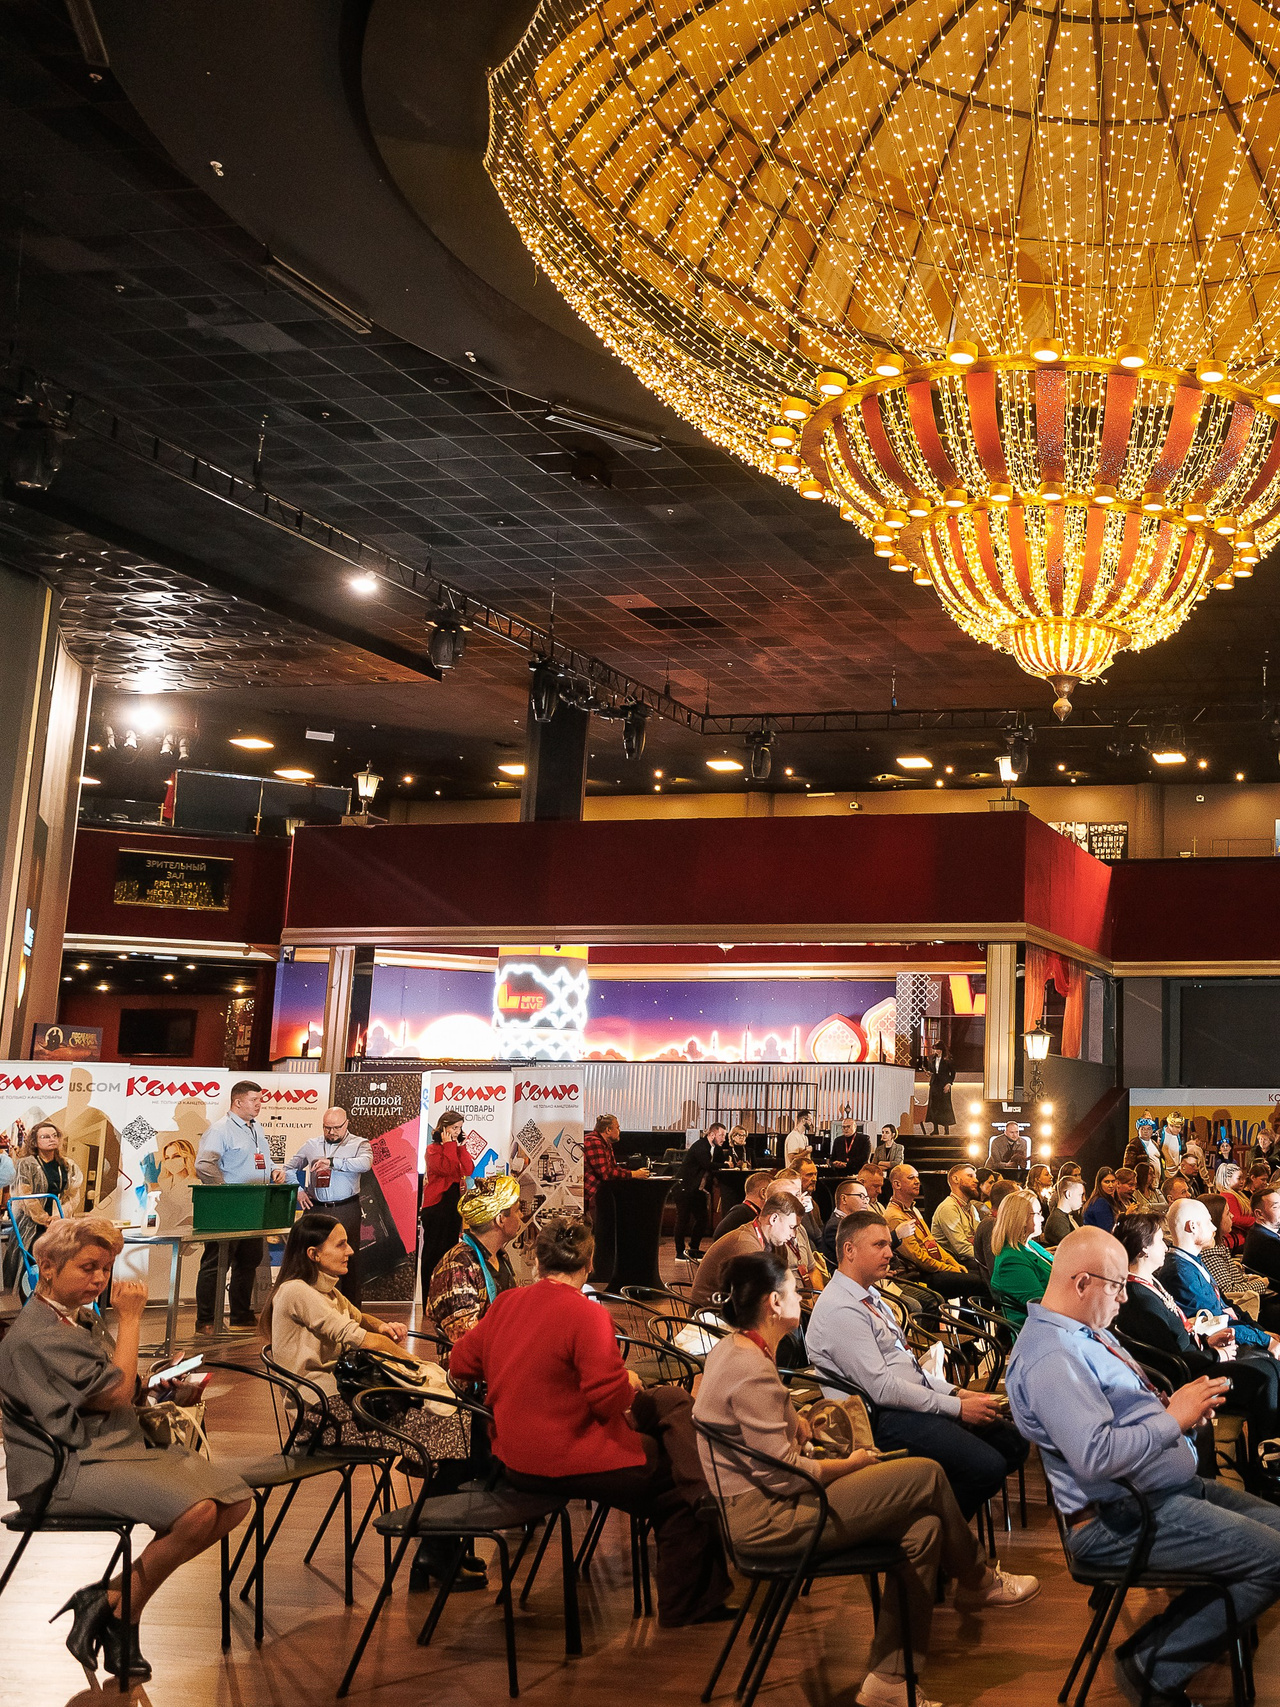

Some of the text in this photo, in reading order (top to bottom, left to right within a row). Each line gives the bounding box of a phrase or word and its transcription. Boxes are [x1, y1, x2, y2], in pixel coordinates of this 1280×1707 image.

[145, 859, 206, 871] ЗРИТЕЛЬНЫЙ
[166, 871, 185, 880] ЗАЛ
[146, 889, 174, 898] МЕСТА
[0, 1073, 64, 1092] омус
[69, 1082, 121, 1093] US.COM
[126, 1075, 221, 1098] Комус
[260, 1088, 319, 1104] омус
[434, 1081, 507, 1104] Комус
[514, 1080, 579, 1104] Комус
[352, 1095, 403, 1107] ДЕЛОВОЙ
[350, 1106, 404, 1117] СТАНДАРТ
[445, 1104, 495, 1114] КАНЦТОВАРЫ
